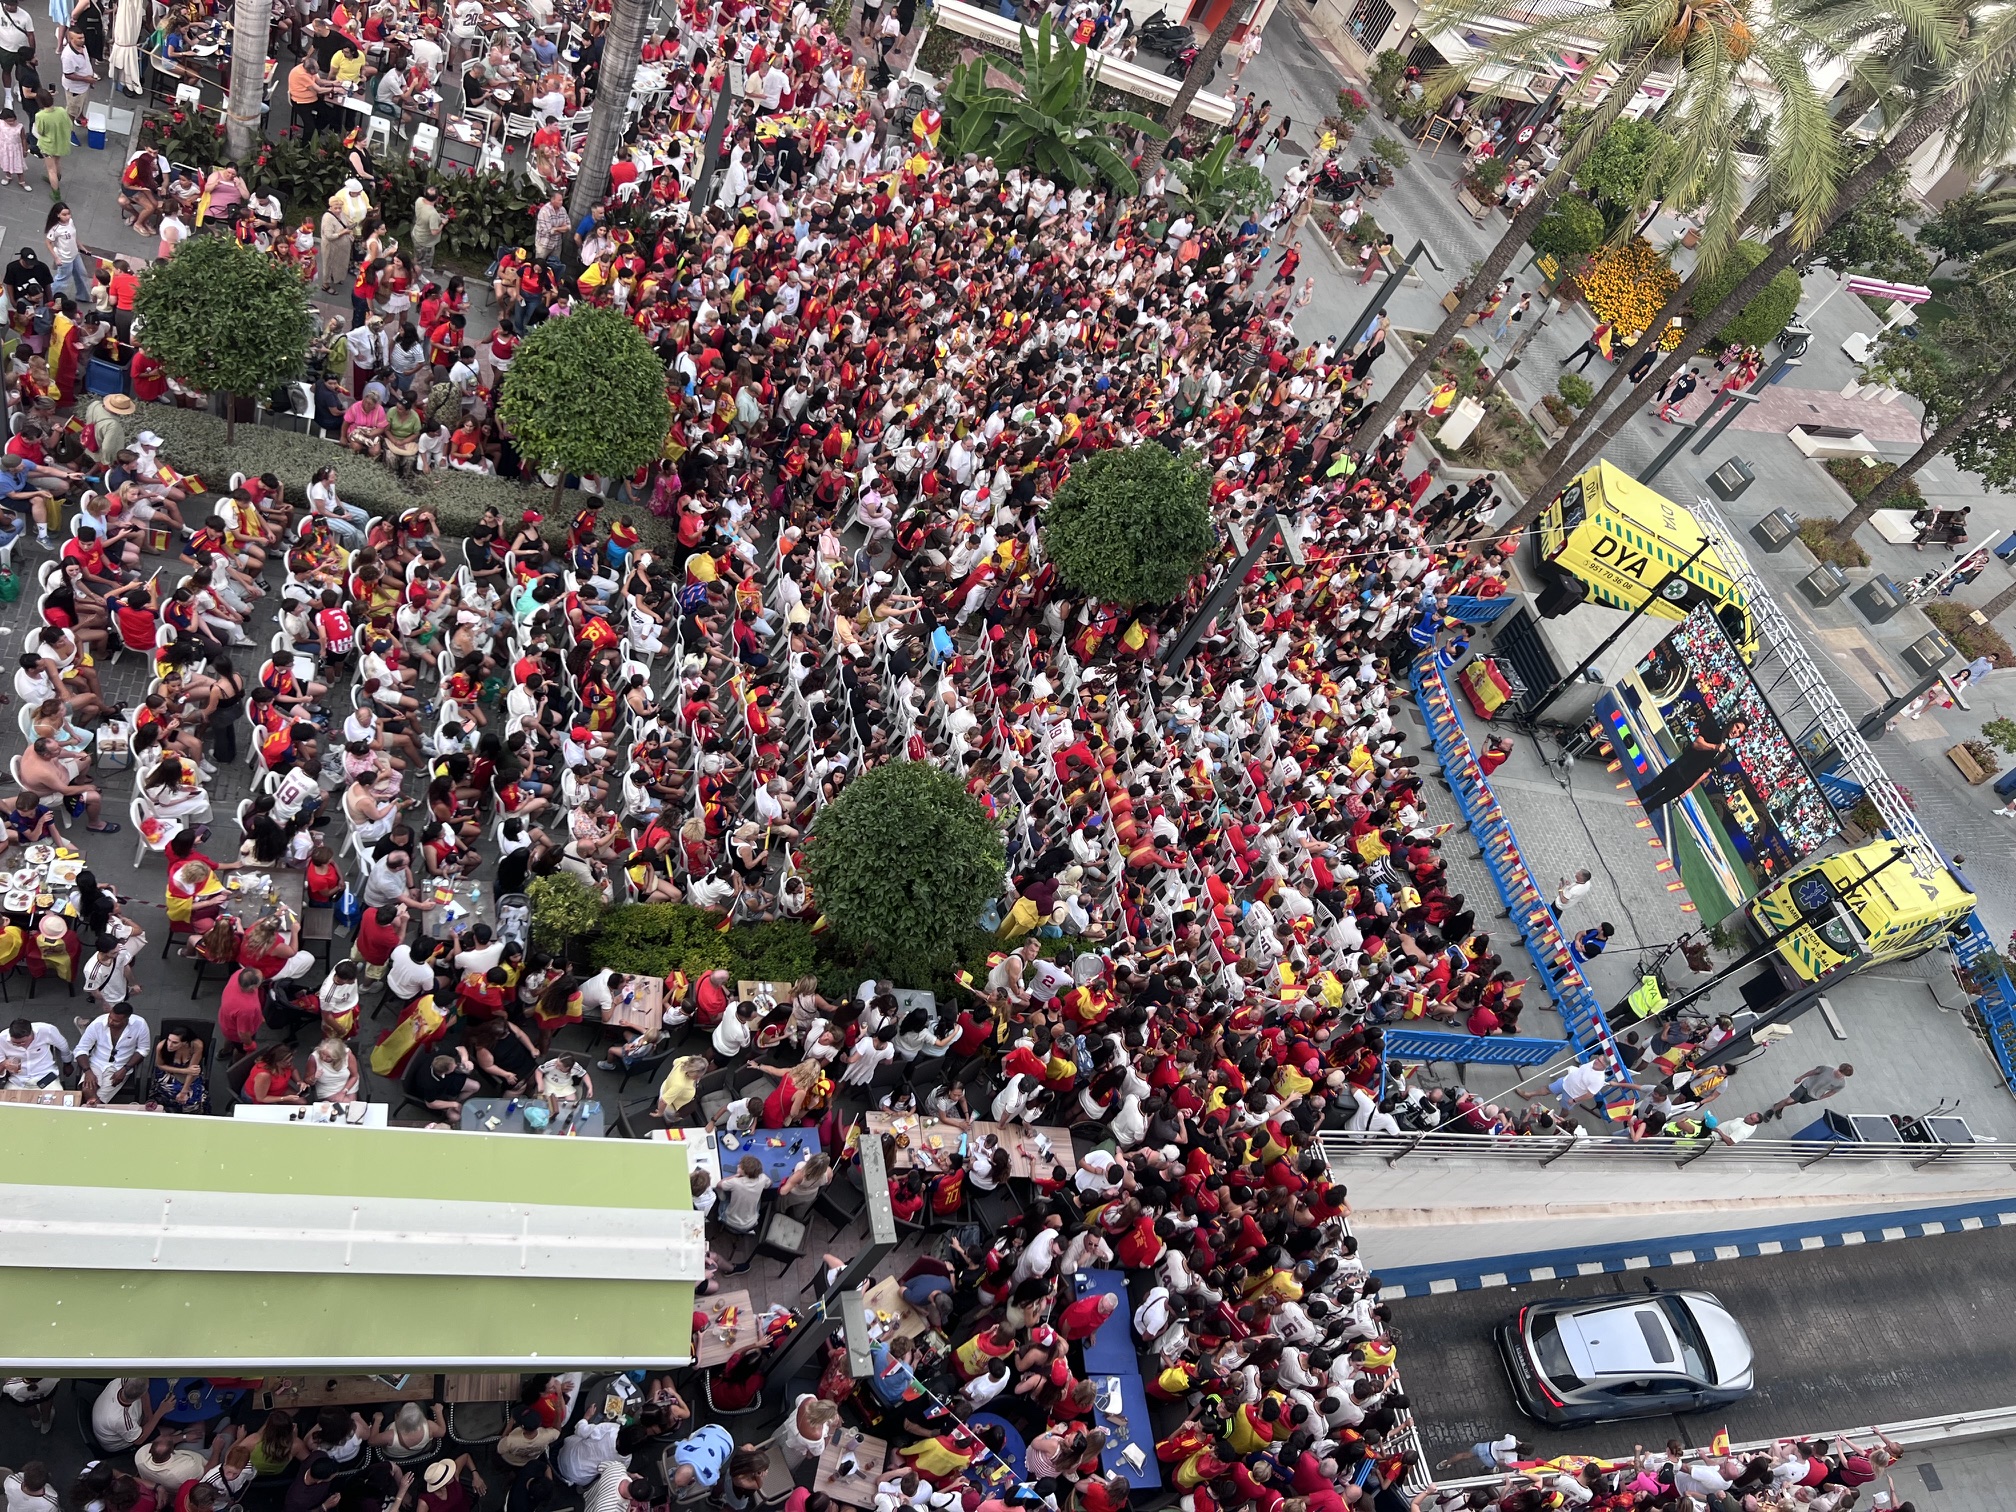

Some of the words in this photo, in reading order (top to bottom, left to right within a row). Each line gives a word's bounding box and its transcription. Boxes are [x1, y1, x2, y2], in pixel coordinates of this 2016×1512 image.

[1586, 481, 1596, 502] DYA
[1661, 503, 1677, 531] DYA
[1590, 535, 1649, 579] DYA
[1588, 562, 1602, 574] 951
[1602, 570, 1614, 579] 70
[1612, 576, 1622, 585] 36
[1622, 581, 1633, 590] 08
[334, 614, 348, 631] 3
[581, 626, 600, 642] 19
[1693, 702, 1707, 723] FIFA
[276, 780, 300, 804] 19
[1771, 836, 1783, 855] THE
[1835, 876, 1867, 914] DYA
[1786, 904, 1820, 949] AMBLANCIA
[1041, 975, 1056, 988] 2
[1646, 979, 1658, 1000] DYA
[1281, 1322, 1298, 1338] 6
[1293, 1316, 1306, 1331] MERINO
